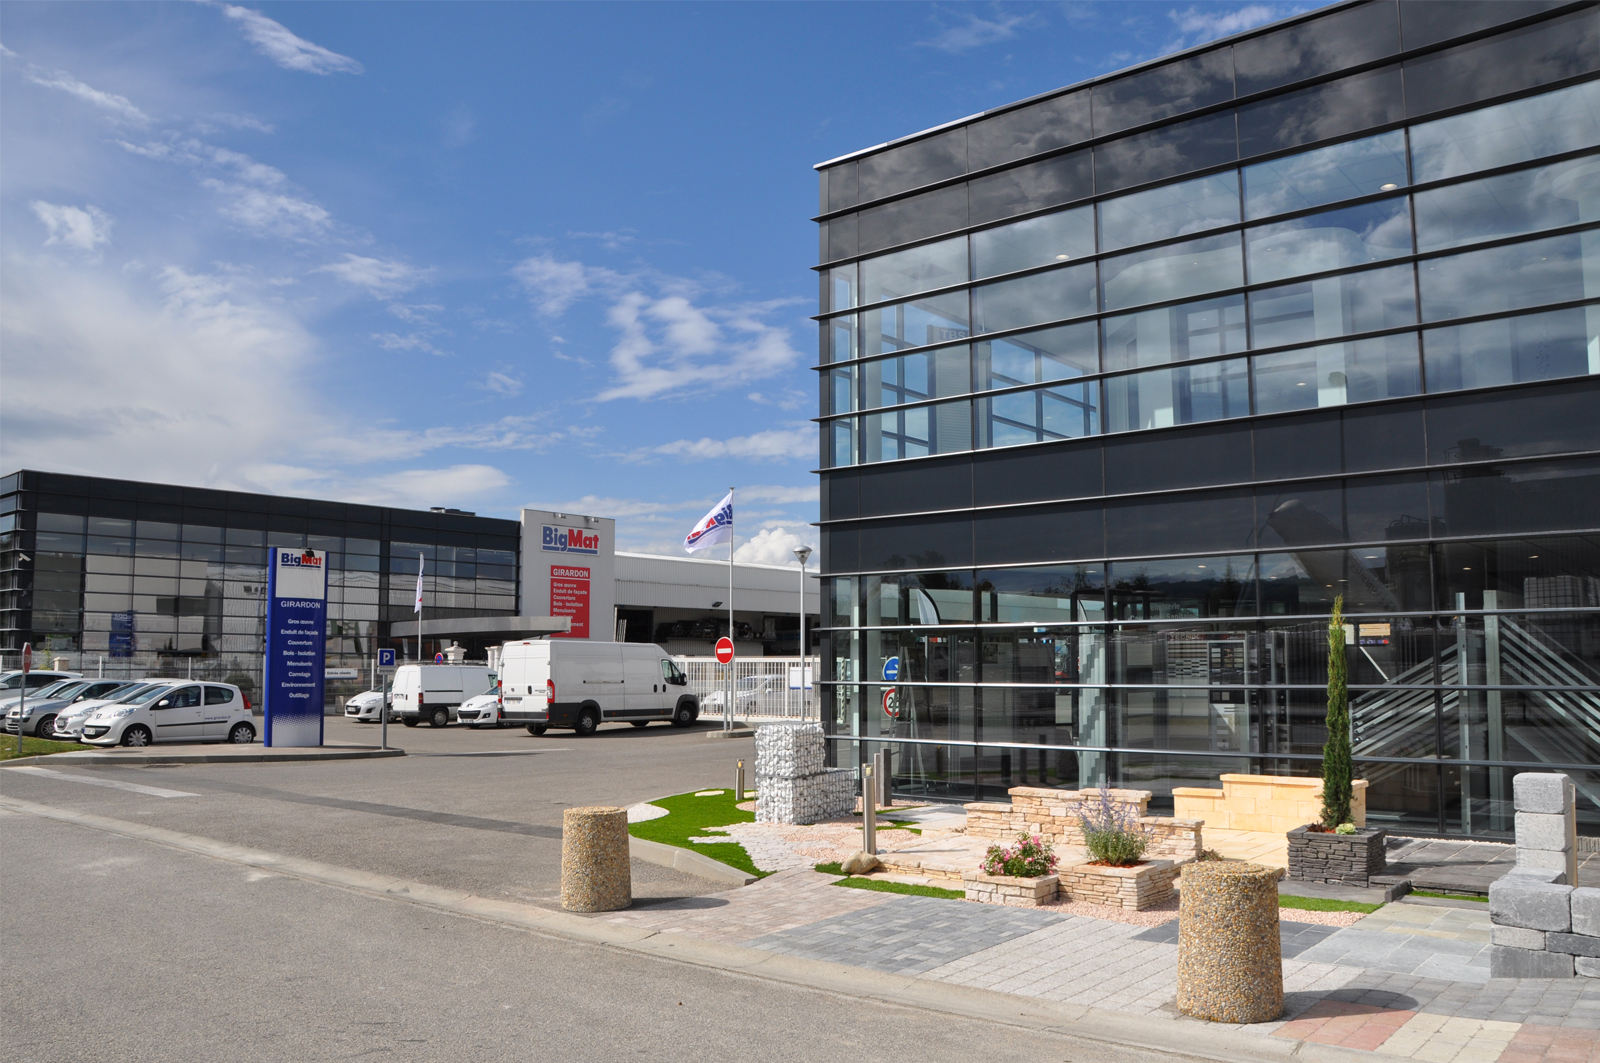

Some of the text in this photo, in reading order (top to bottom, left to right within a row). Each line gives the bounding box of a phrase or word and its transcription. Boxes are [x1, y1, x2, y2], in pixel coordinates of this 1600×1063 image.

[543, 526, 599, 551] BigMat
[281, 552, 322, 567] BigMat
[553, 568, 588, 577] GIRARDON
[281, 600, 320, 608] GIRARDON
[383, 652, 391, 664] P
